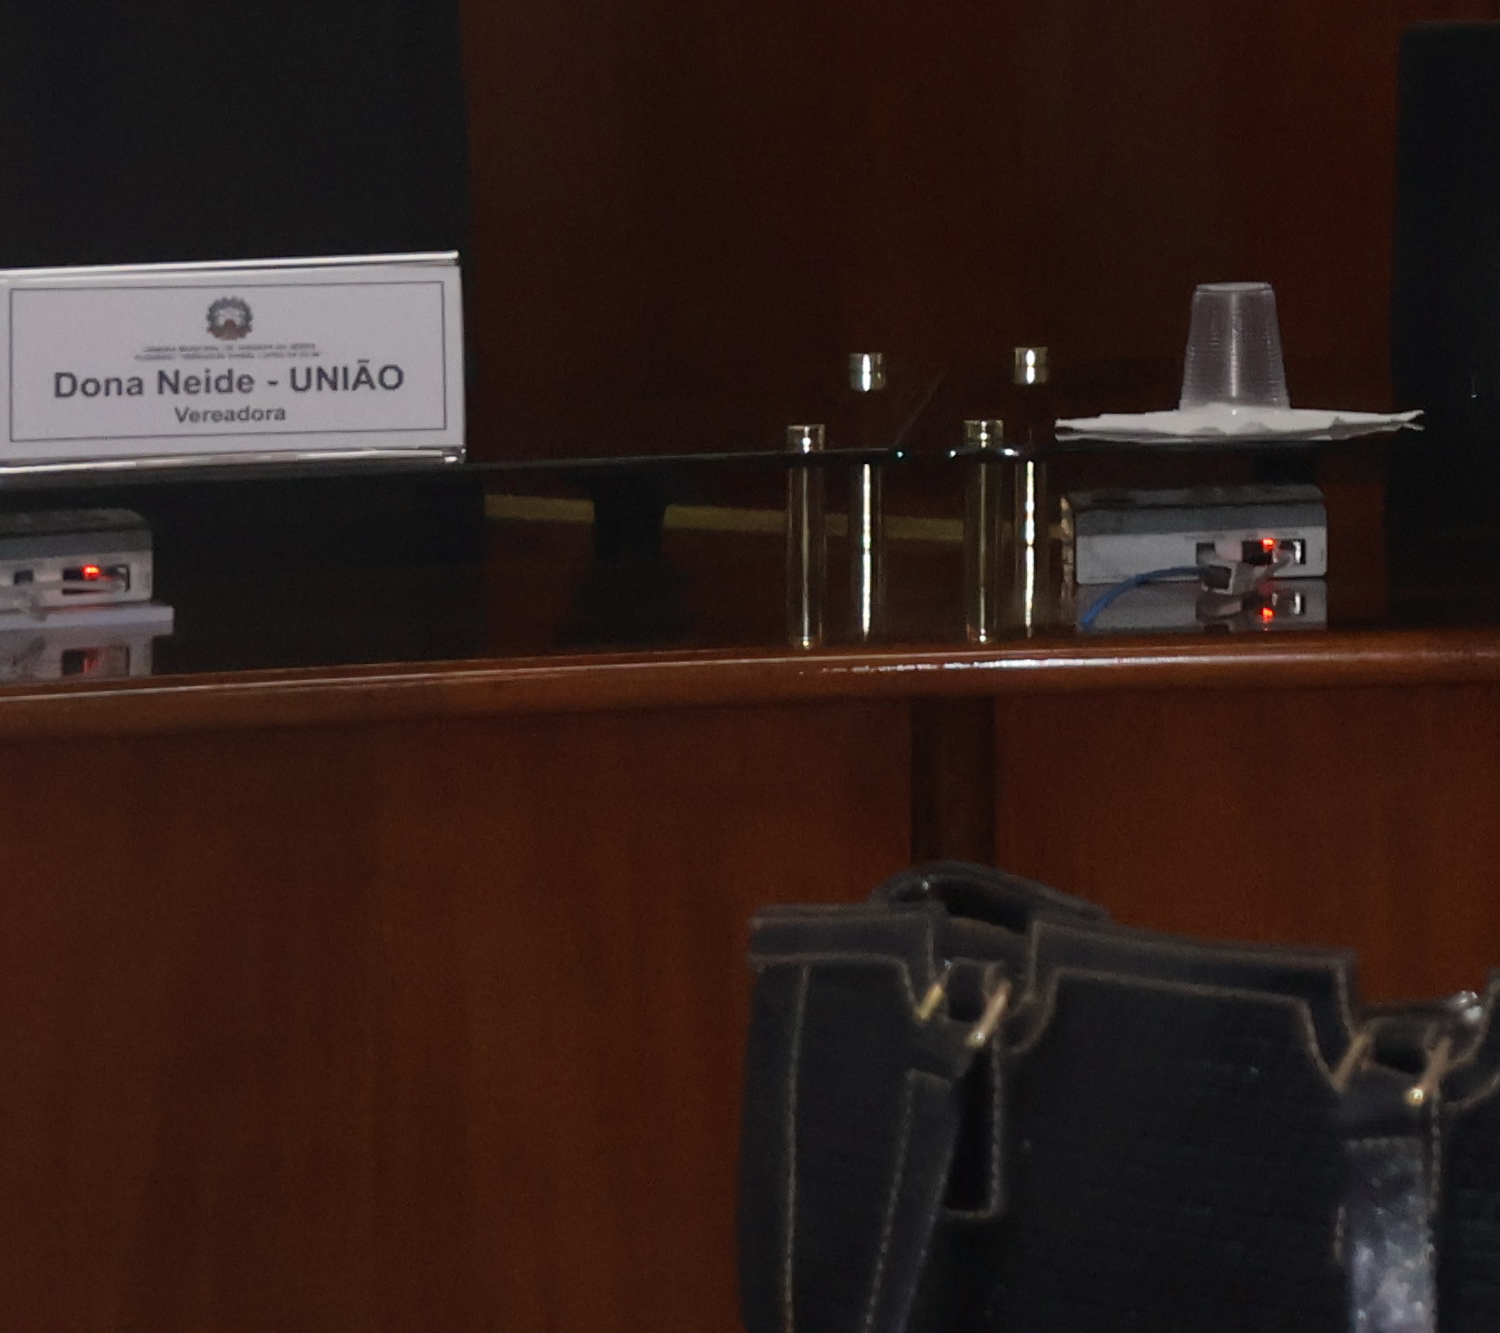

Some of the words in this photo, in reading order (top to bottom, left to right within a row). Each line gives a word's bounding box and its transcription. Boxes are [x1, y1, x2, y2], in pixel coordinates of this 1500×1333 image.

[54, 371, 144, 398] Dona
[157, 368, 255, 395] Neide
[290, 359, 404, 393] UNIÃO
[174, 405, 287, 425] Vereadora
